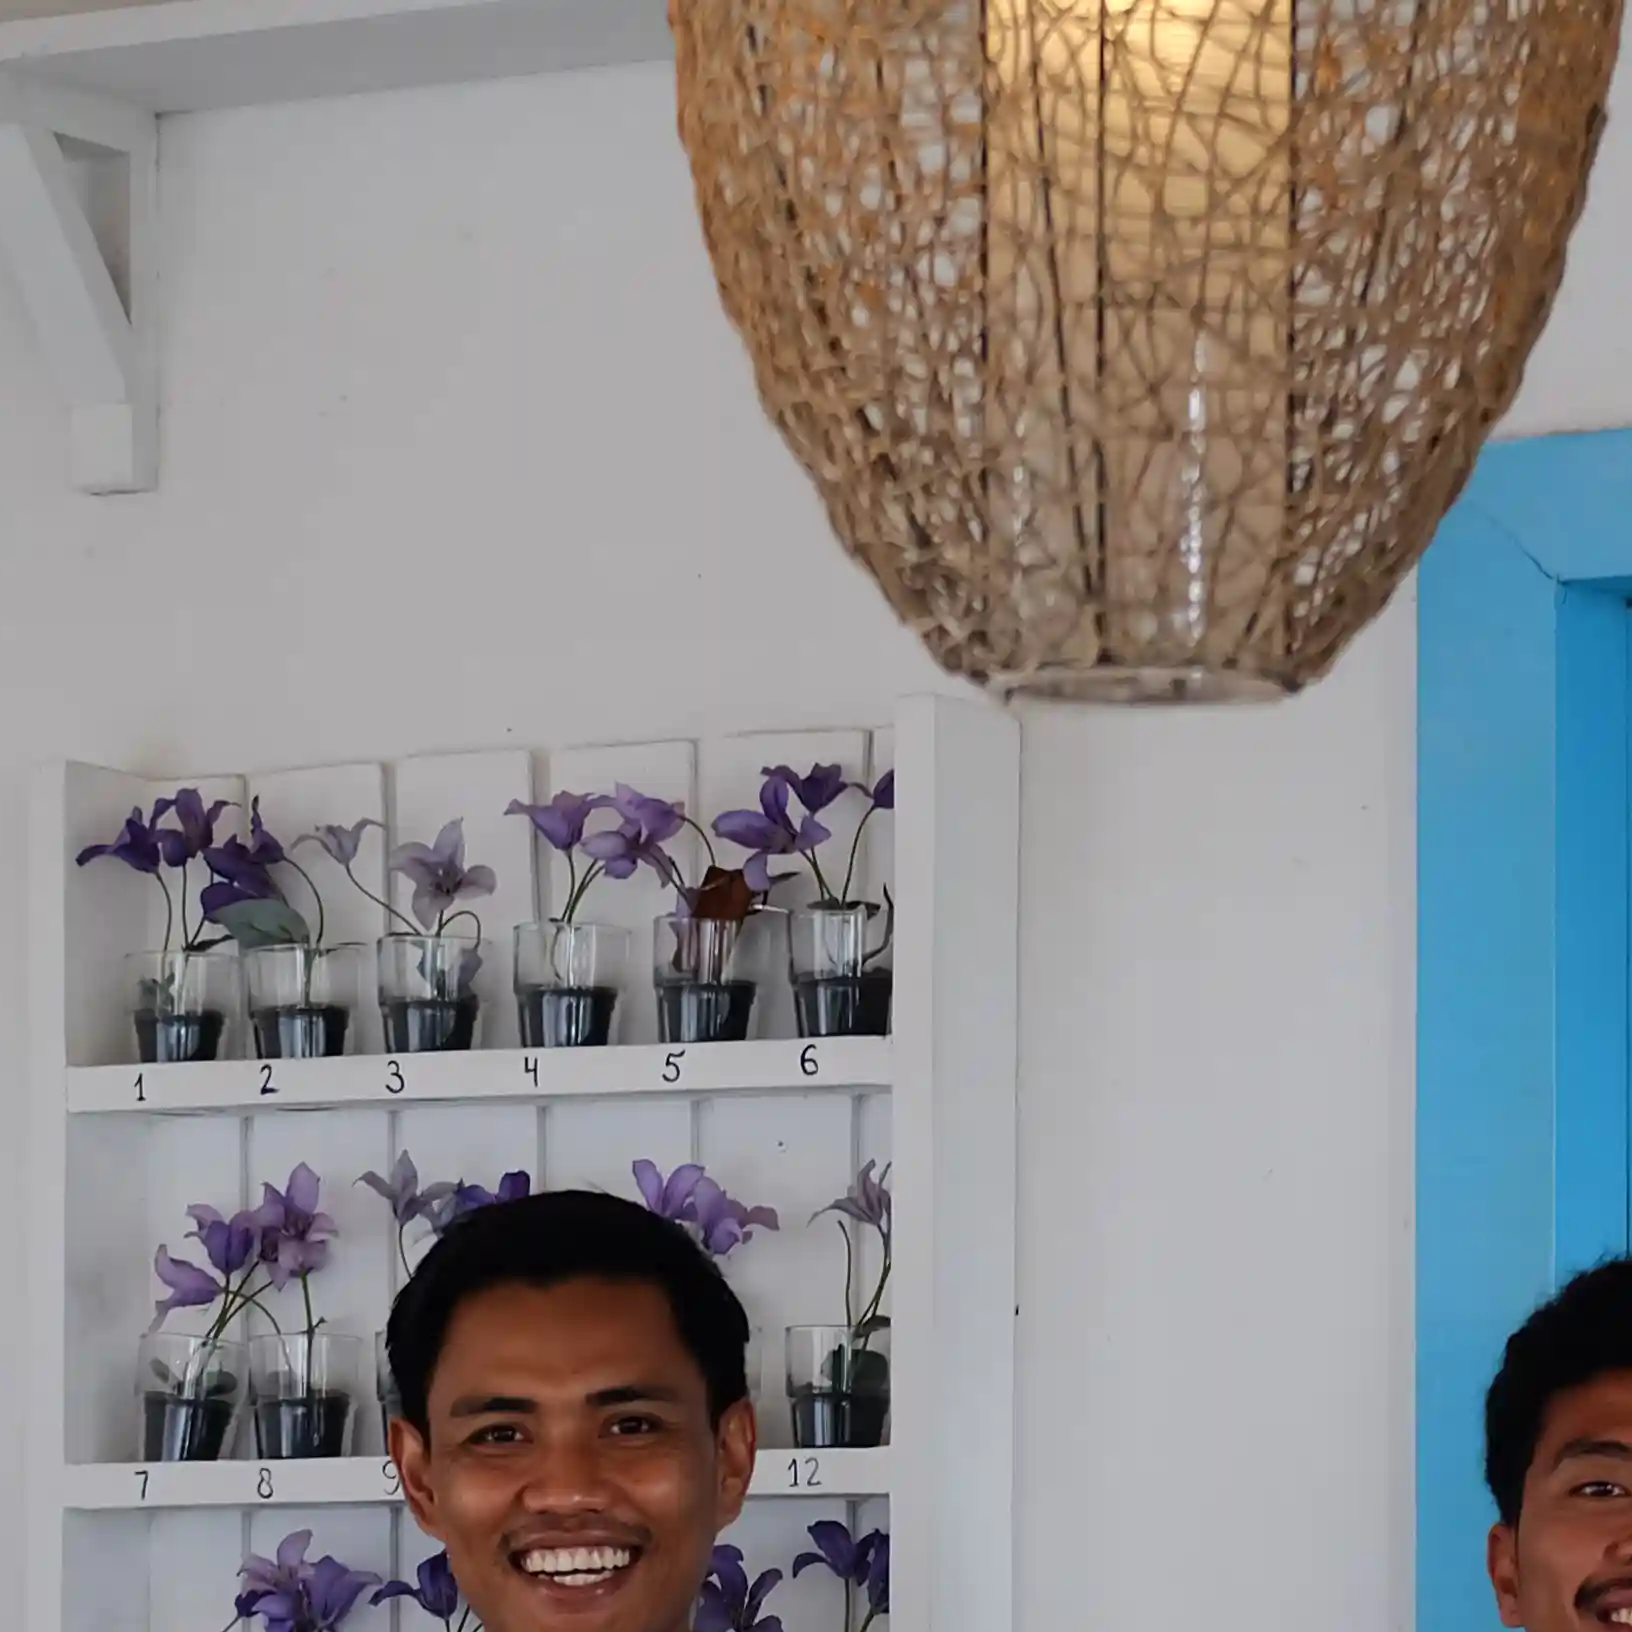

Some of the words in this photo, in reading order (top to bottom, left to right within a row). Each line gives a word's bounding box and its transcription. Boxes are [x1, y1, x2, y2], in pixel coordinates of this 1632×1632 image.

[134, 1071, 147, 1102] 1
[259, 1063, 281, 1096] 2
[385, 1059, 406, 1095] 3
[524, 1056, 539, 1088] 4
[661, 1048, 687, 1084] 5
[799, 1043, 819, 1077] 6
[134, 1469, 150, 1501] 7
[256, 1467, 274, 1500] 8
[381, 1459, 401, 1496] 9
[787, 1457, 823, 1488] 12
